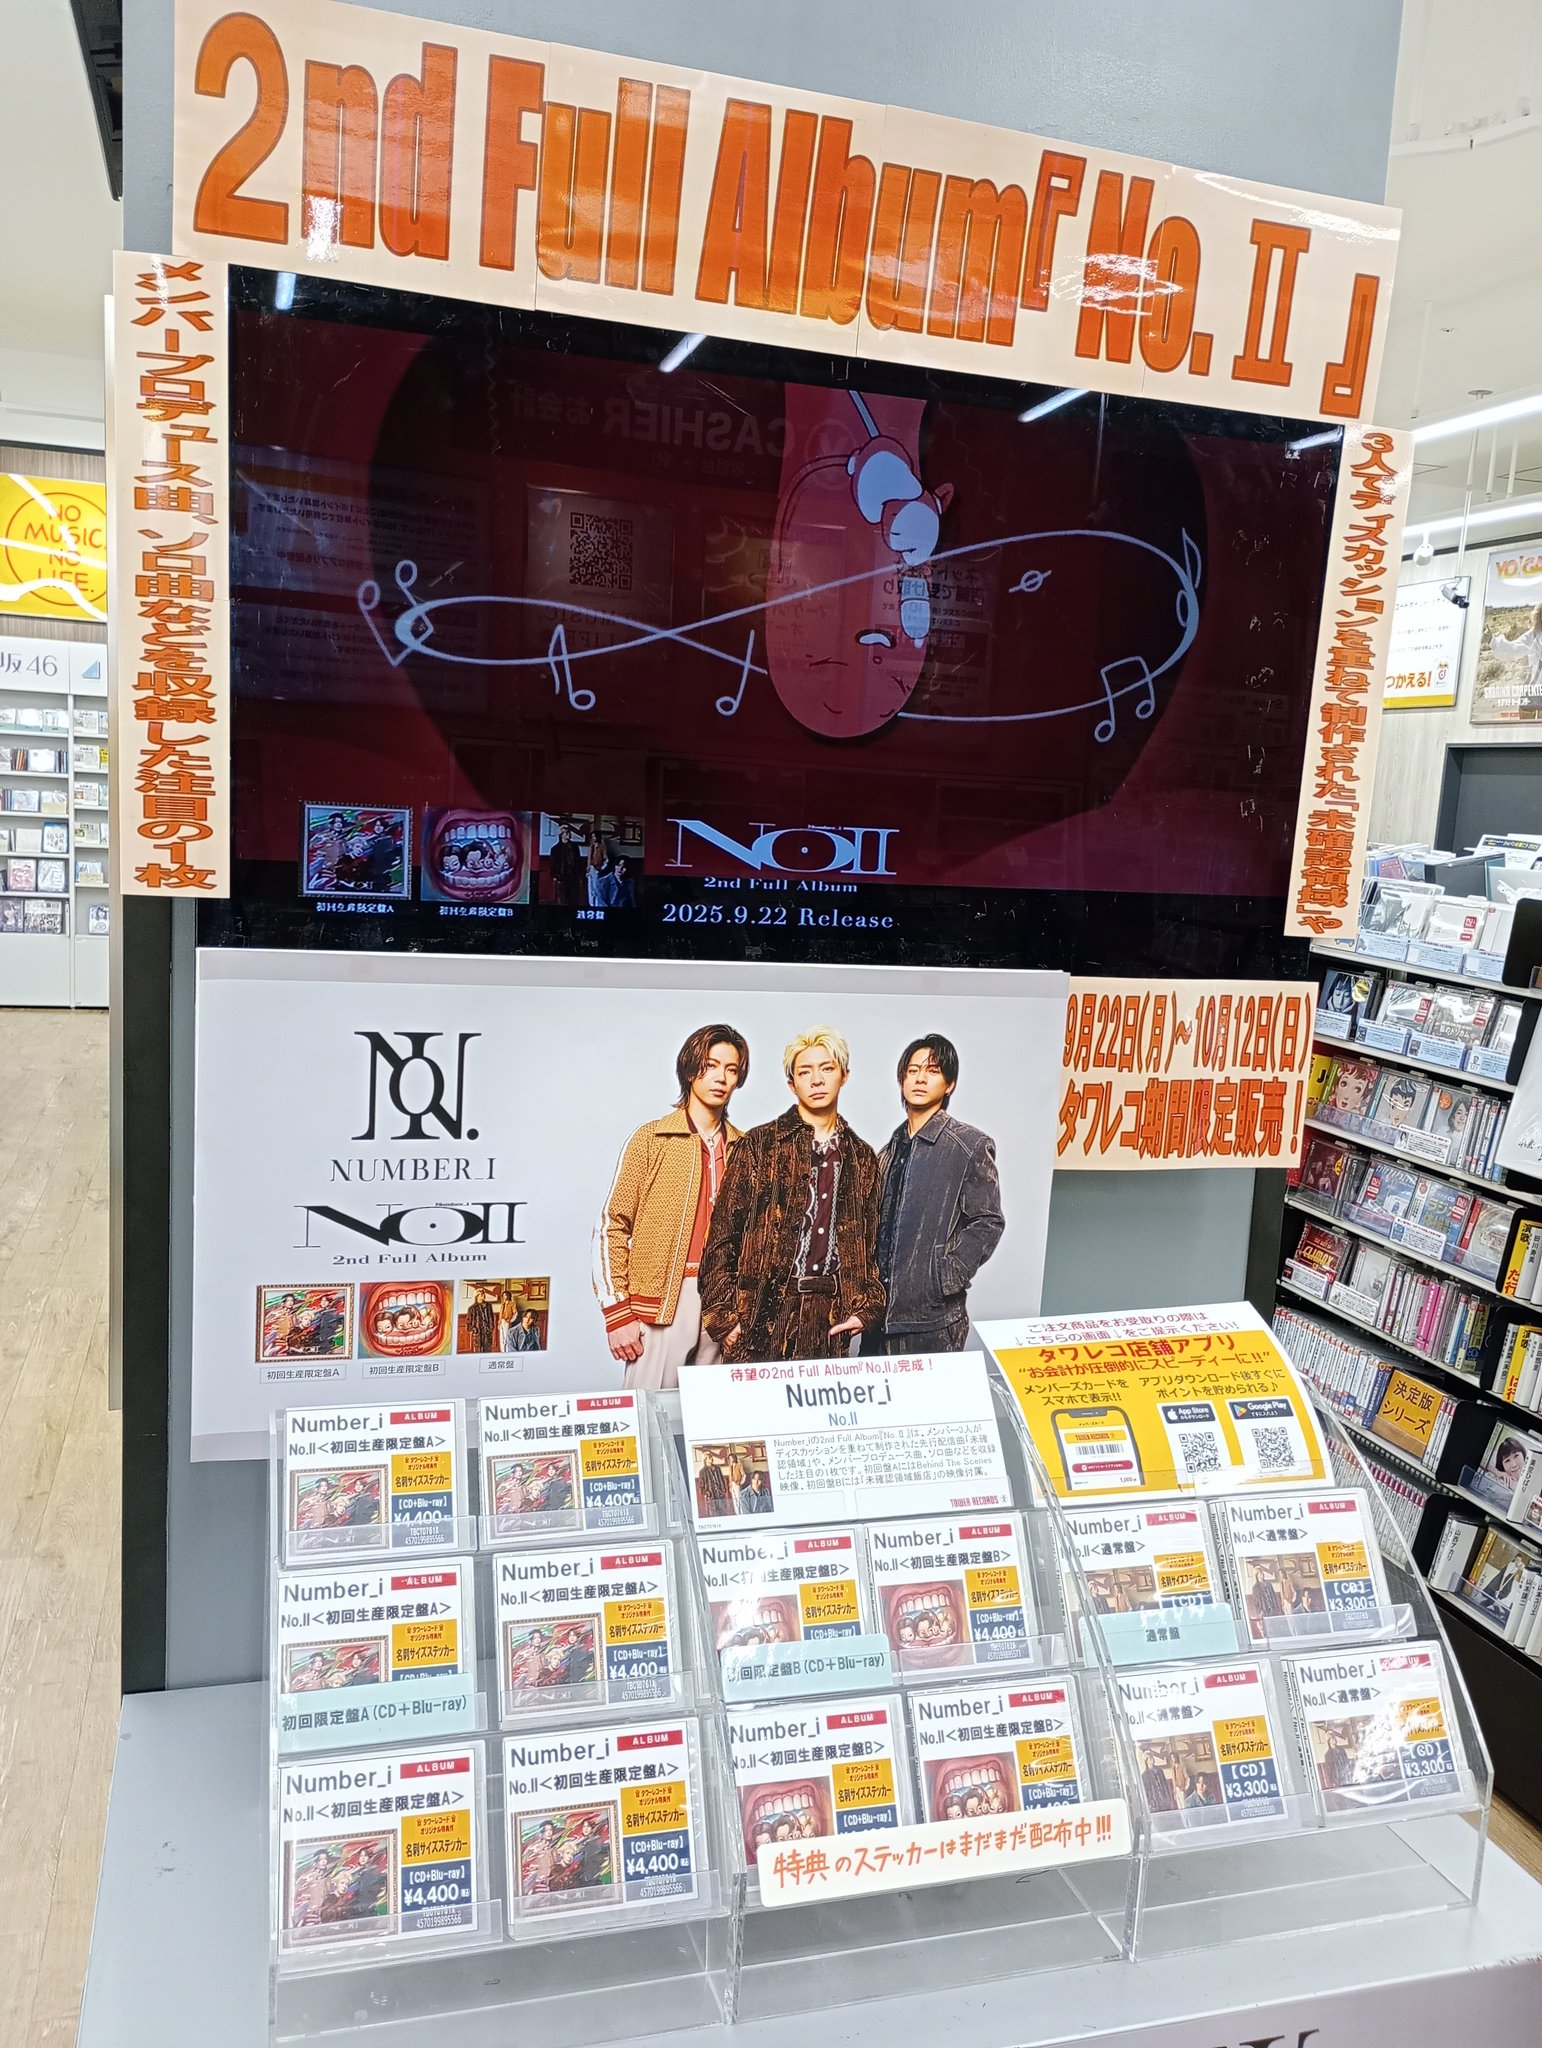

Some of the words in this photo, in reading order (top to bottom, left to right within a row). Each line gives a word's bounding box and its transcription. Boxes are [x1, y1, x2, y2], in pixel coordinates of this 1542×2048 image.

[194, 11, 458, 261] 2nd
[479, 53, 691, 296] Full
[49, 504, 81, 522] NO
[49, 550, 81, 567] NO
[704, 876, 741, 889] 2nd
[750, 878, 788, 891] Full
[796, 880, 858, 892] Album
[662, 904, 787, 926] 2025.9.22
[798, 907, 894, 929] Release
[1057, 1076, 1305, 1160] タワレコ期間限定販売!
[330, 1157, 496, 1182] NUMBER_I
[332, 1254, 370, 1266] 2nd
[378, 1253, 417, 1265] Full
[426, 1252, 487, 1264] Album
[1504, 1268, 1520, 1297] た行
[1028, 1312, 1209, 1334] ご注文商品をお受取りの際は
[1026, 1329, 1111, 1346] こちらの画面
[1038, 1334, 1236, 1365] タワレコ店舗アプリ
[369, 1363, 440, 1376] 初回生産限定盤B
[487, 1360, 515, 1370] 通常盤
[730, 1364, 795, 1382] 待望の2nd
[799, 1363, 821, 1378] Full
[267, 1369, 340, 1381] 初回生産限定盤A
[1138, 1368, 1286, 1386] アプリダウンロード後すぐに
[786, 1379, 892, 1408] Number_i
[1024, 1378, 1129, 1395] メンバーズカードを
[1393, 1380, 1436, 1412] 決定版
[1041, 1393, 1122, 1406] スマホで表示!!
[1248, 1402, 1272, 1411] Google
[1272, 1402, 1287, 1410] Play
[485, 1400, 570, 1421] Number_i
[590, 1398, 621, 1407] ALBUM
[1382, 1400, 1432, 1436] シリーズ
[292, 1413, 383, 1433] Number_i
[404, 1412, 437, 1421] ALBUM
[828, 1412, 858, 1427] No.II
[838, 1434, 852, 1442] Full
[946, 1459, 961, 1467] The
[963, 1457, 993, 1466] Scenes
[589, 1481, 635, 1493] 【CD+Blu-ray】
[399, 1495, 447, 1509] 【CD+Blu-ray】
[950, 1497, 971, 1508] TOWER
[971, 1495, 999, 1506] RECORDS
[1231, 1503, 1304, 1522] Number_i
[1067, 1515, 1142, 1536] Number_i
[1158, 1512, 1185, 1521] ALBUM
[808, 1539, 839, 1549] ALBUM
[874, 1529, 954, 1549] Number_i
[971, 1527, 1000, 1536] ALBUM
[502, 1558, 594, 1582] Number_i
[615, 1556, 649, 1565] ALBUM
[284, 1578, 383, 1602] Number_i
[406, 1576, 442, 1585] ALBUM
[1146, 1627, 1180, 1642] 通常盤
[1216, 1674, 1246, 1683] ALBUM
[1300, 1660, 1376, 1684] Number_i
[919, 1695, 1003, 1721] Number_i
[1022, 1692, 1053, 1703] ALBUM
[1303, 1687, 1381, 1707] No.II<通常盤>
[730, 1717, 820, 1744] Number_i
[841, 1713, 874, 1724] ALBUM
[511, 1738, 609, 1767] Number_i
[633, 1734, 668, 1745] ALBUM
[286, 1766, 391, 1795] Number_i
[417, 1762, 455, 1773] ALBUM
[1230, 1764, 1267, 1779] 【CD】
[1226, 1779, 1268, 1798] ¥3,300
[843, 1811, 892, 1827] 【CD+Blu-ray】
[406, 1839, 468, 1857] 名刺サイズステッカー
[631, 1836, 684, 1855] 【CD+Blu-ray】
[627, 1853, 679, 1876] ¥4,400
[409, 1865, 465, 1885] 【CD+Blu-ray】
[404, 1884, 459, 1907] ¥4,400
[416, 1915, 461, 1928] 4570199895566
